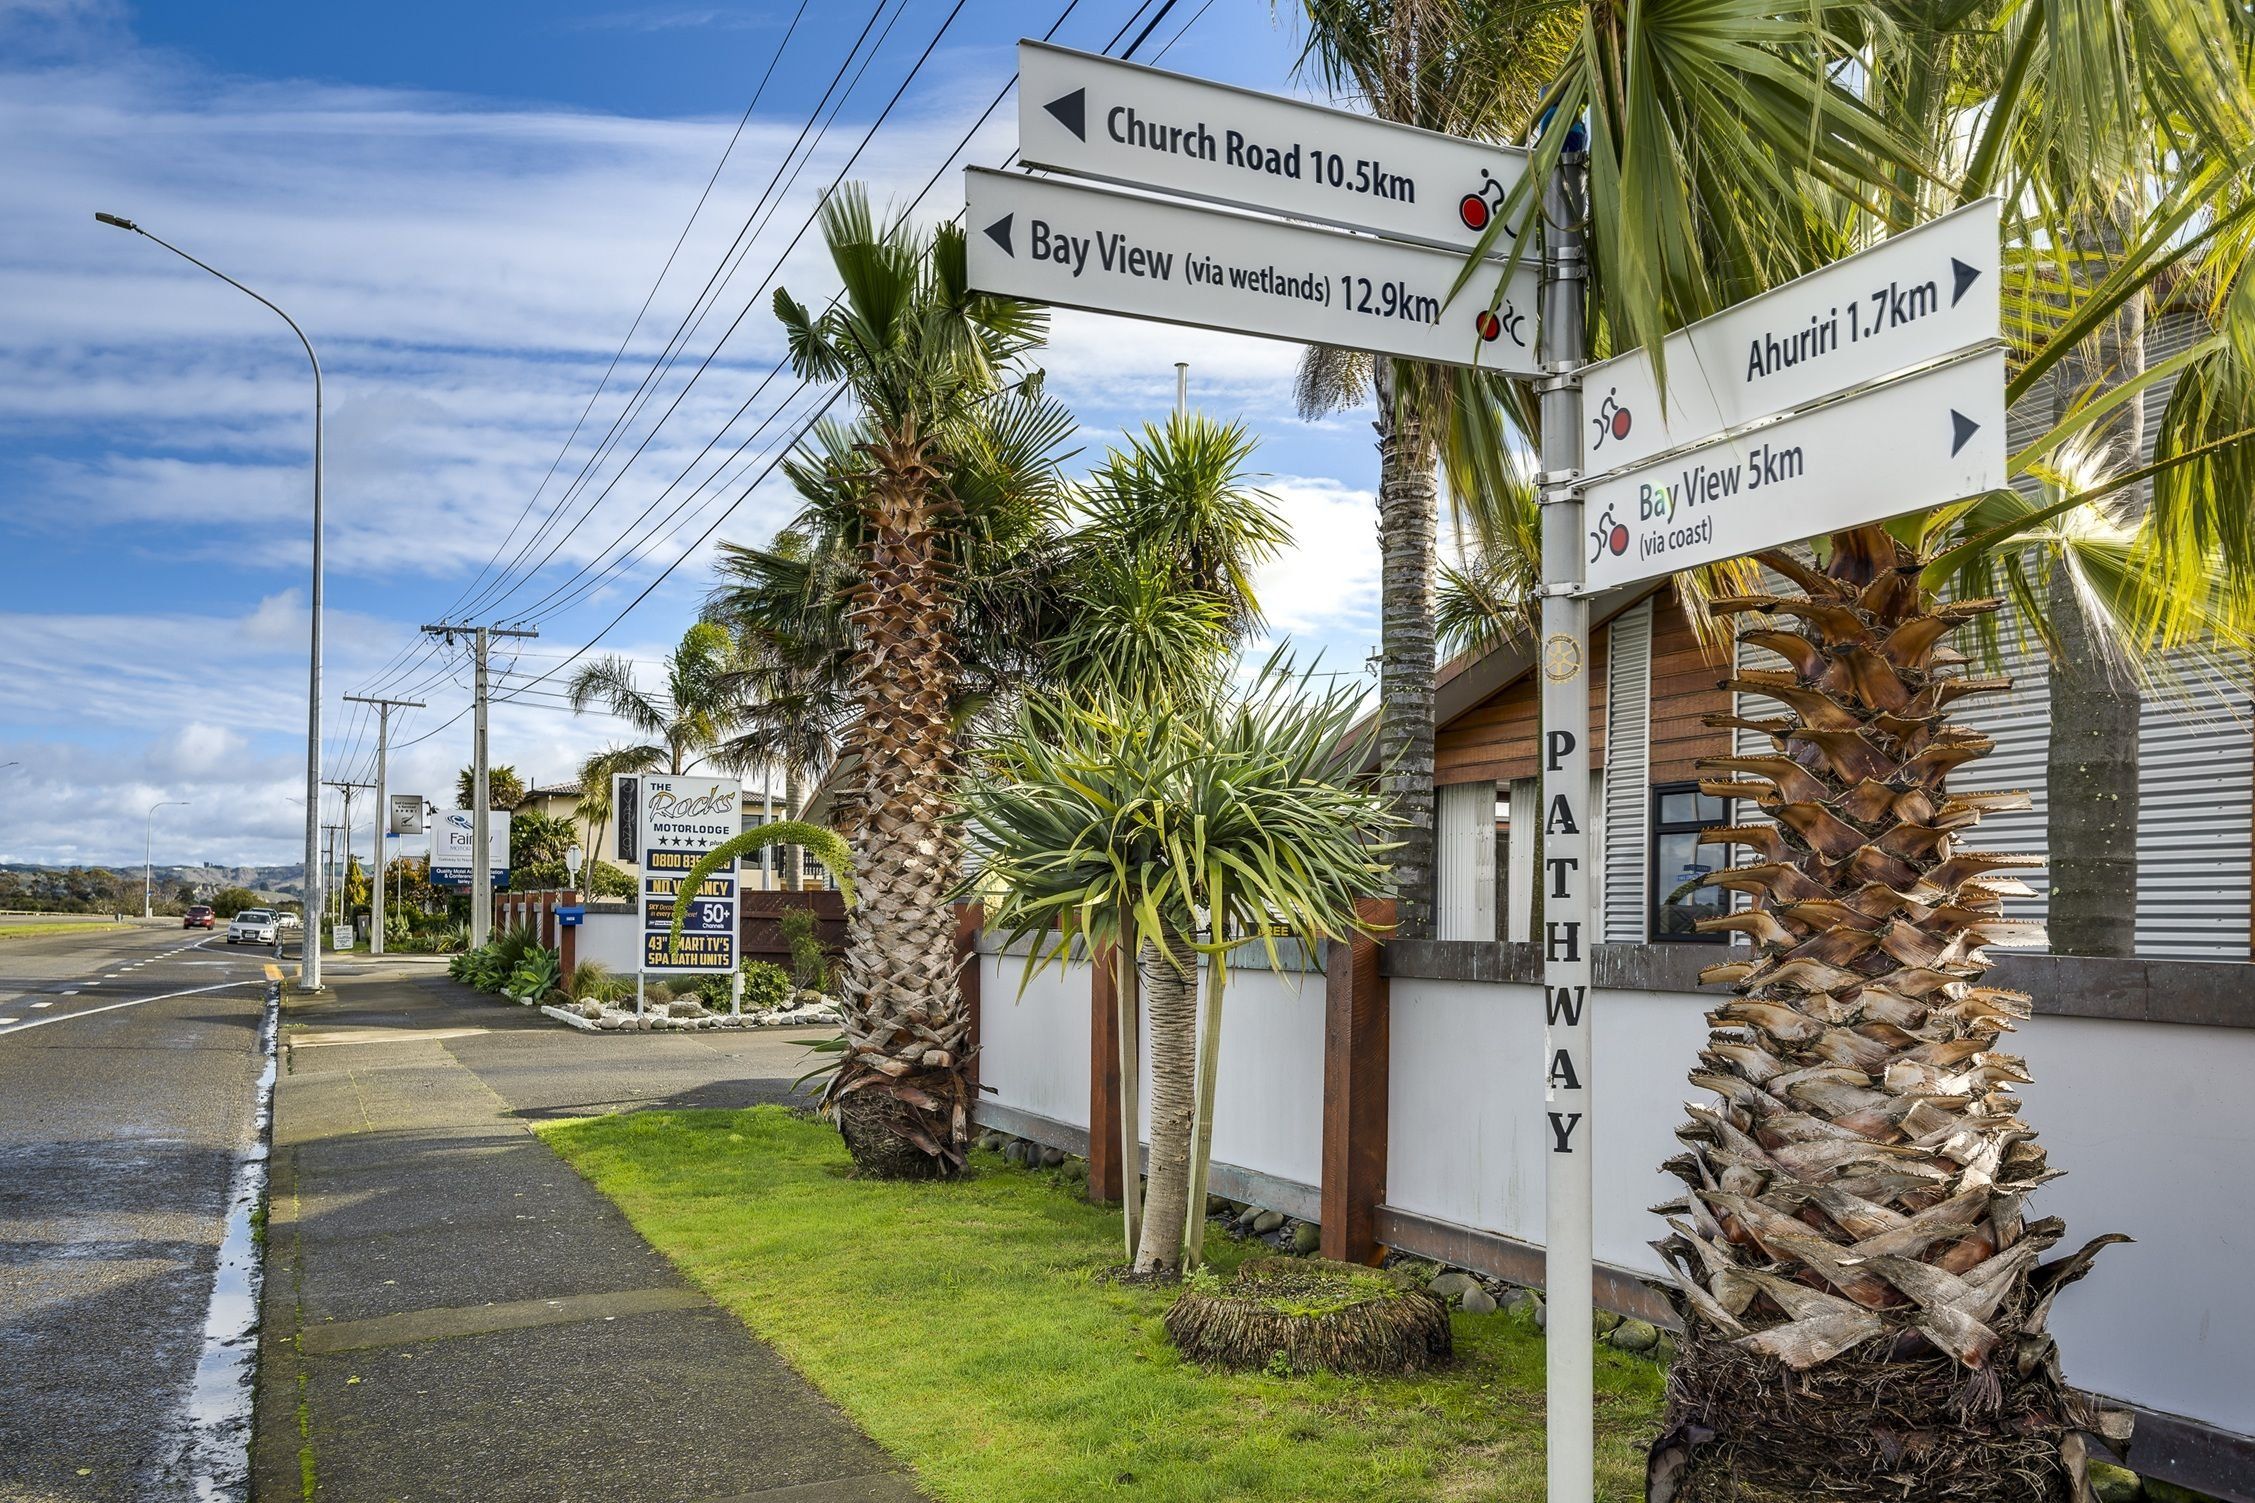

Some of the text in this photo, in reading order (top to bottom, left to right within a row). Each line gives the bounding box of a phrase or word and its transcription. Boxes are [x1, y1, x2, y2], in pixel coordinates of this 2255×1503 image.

[1107, 106, 1416, 203] Church Road 10.5km
[1031, 219, 1440, 326] Bay View (via wetlands) 12.9km
[1746, 280, 1938, 383] Ahuriri 1.7km
[1640, 443, 1804, 525] Bay View 5km
[1640, 514, 1713, 561] (via coast)
[649, 784, 736, 823] Rocks
[650, 782, 672, 792] THE
[653, 823, 730, 835] MOTORLODGE
[652, 853, 681, 868] 0800
[652, 879, 670, 893] NO
[702, 904, 731, 923] 50+
[648, 952, 669, 965] SPA
[699, 953, 729, 966] UNITS
[1544, 730, 1587, 1154] PATHWAY
